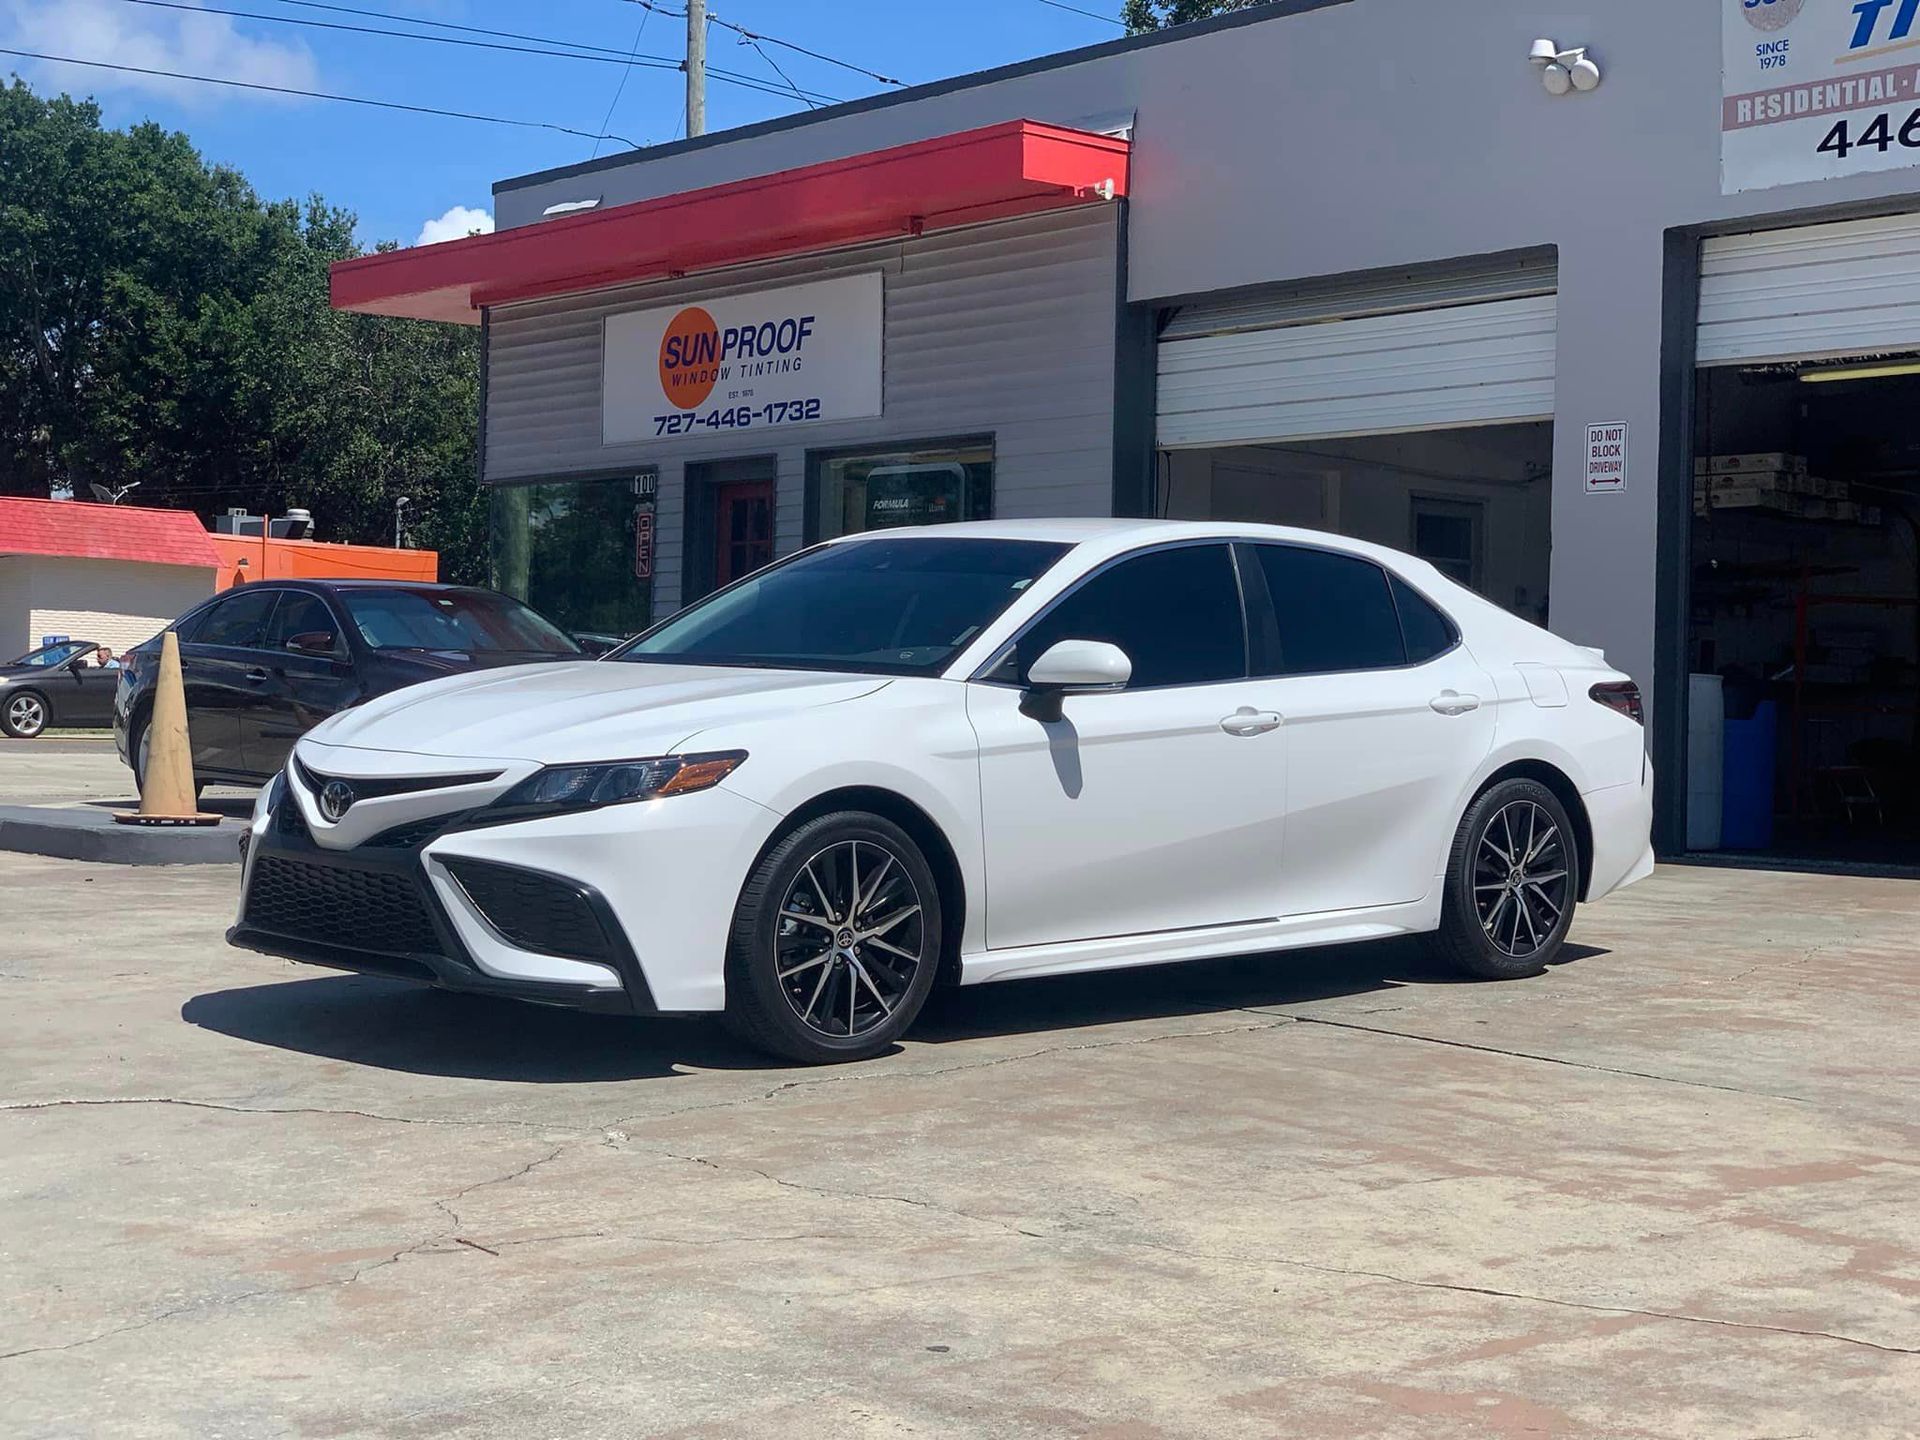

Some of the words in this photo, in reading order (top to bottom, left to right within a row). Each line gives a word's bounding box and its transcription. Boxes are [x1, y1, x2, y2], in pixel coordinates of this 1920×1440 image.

[1756, 39, 1789, 56] SINCE
[1760, 55, 1786, 70] 1978
[1737, 74, 1897, 123] RESIDENTIAL
[672, 366, 731, 387] WINDOW
[741, 357, 801, 378] TINTING
[653, 398, 820, 436] 727-446-1732
[1591, 430, 1603, 442] DO
[1605, 429, 1623, 441] NOT
[1592, 445, 1621, 457] BLOCK
[1590, 460, 1622, 473] DRIVEWAY
[873, 498, 909, 511] FORMULA
[639, 517, 650, 573] OPEN
